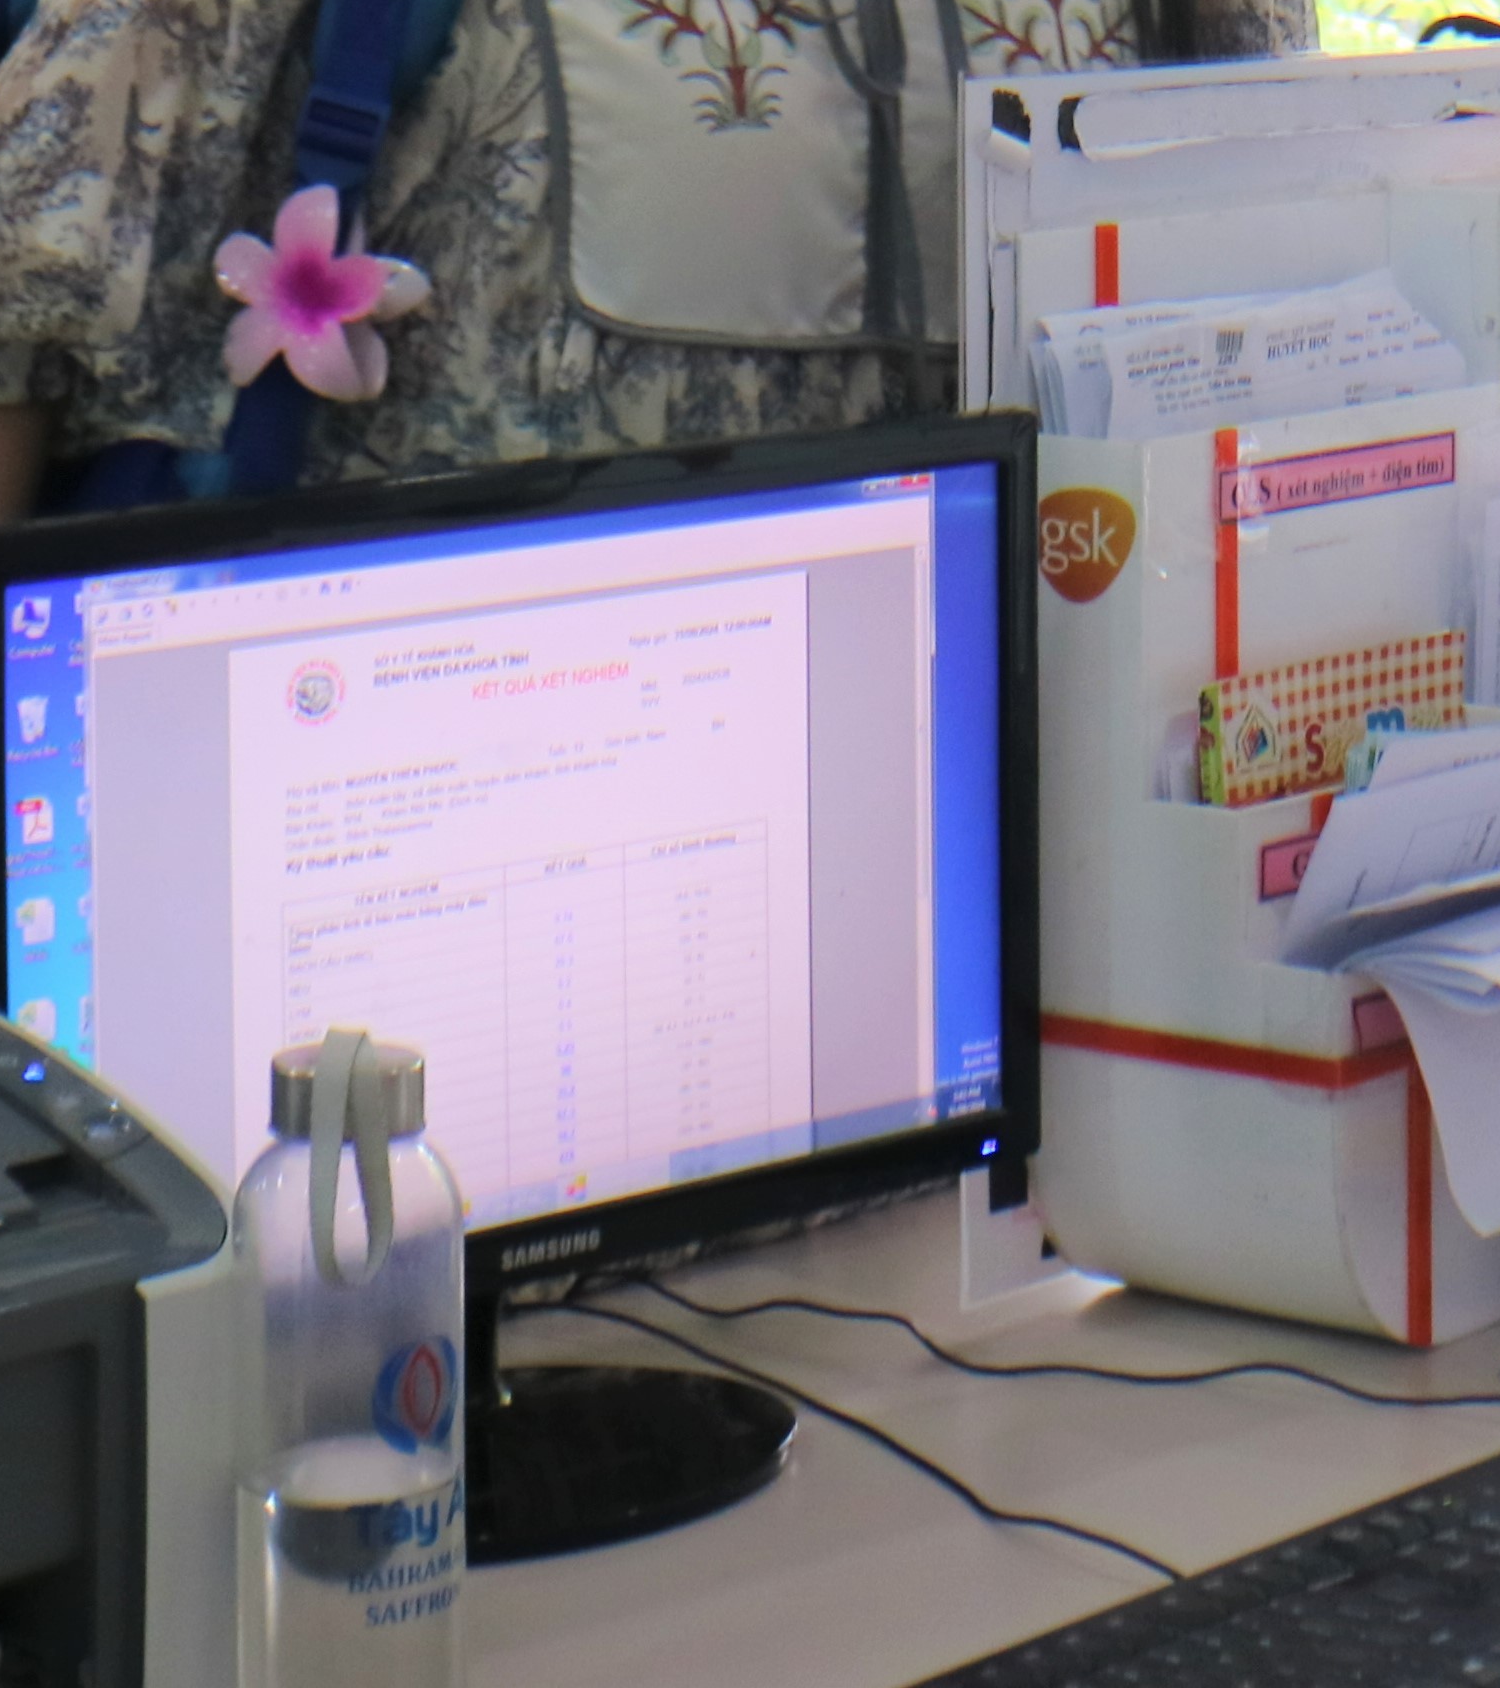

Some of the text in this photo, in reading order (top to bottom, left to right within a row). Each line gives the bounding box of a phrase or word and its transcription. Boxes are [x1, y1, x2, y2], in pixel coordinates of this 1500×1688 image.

[1041, 512, 1117, 574] gsk
[472, 679, 500, 701] KẾT
[540, 669, 568, 691] XÉT
[501, 1228, 601, 1271] SAMSUNG
[348, 1550, 455, 1594] BAHRAM
